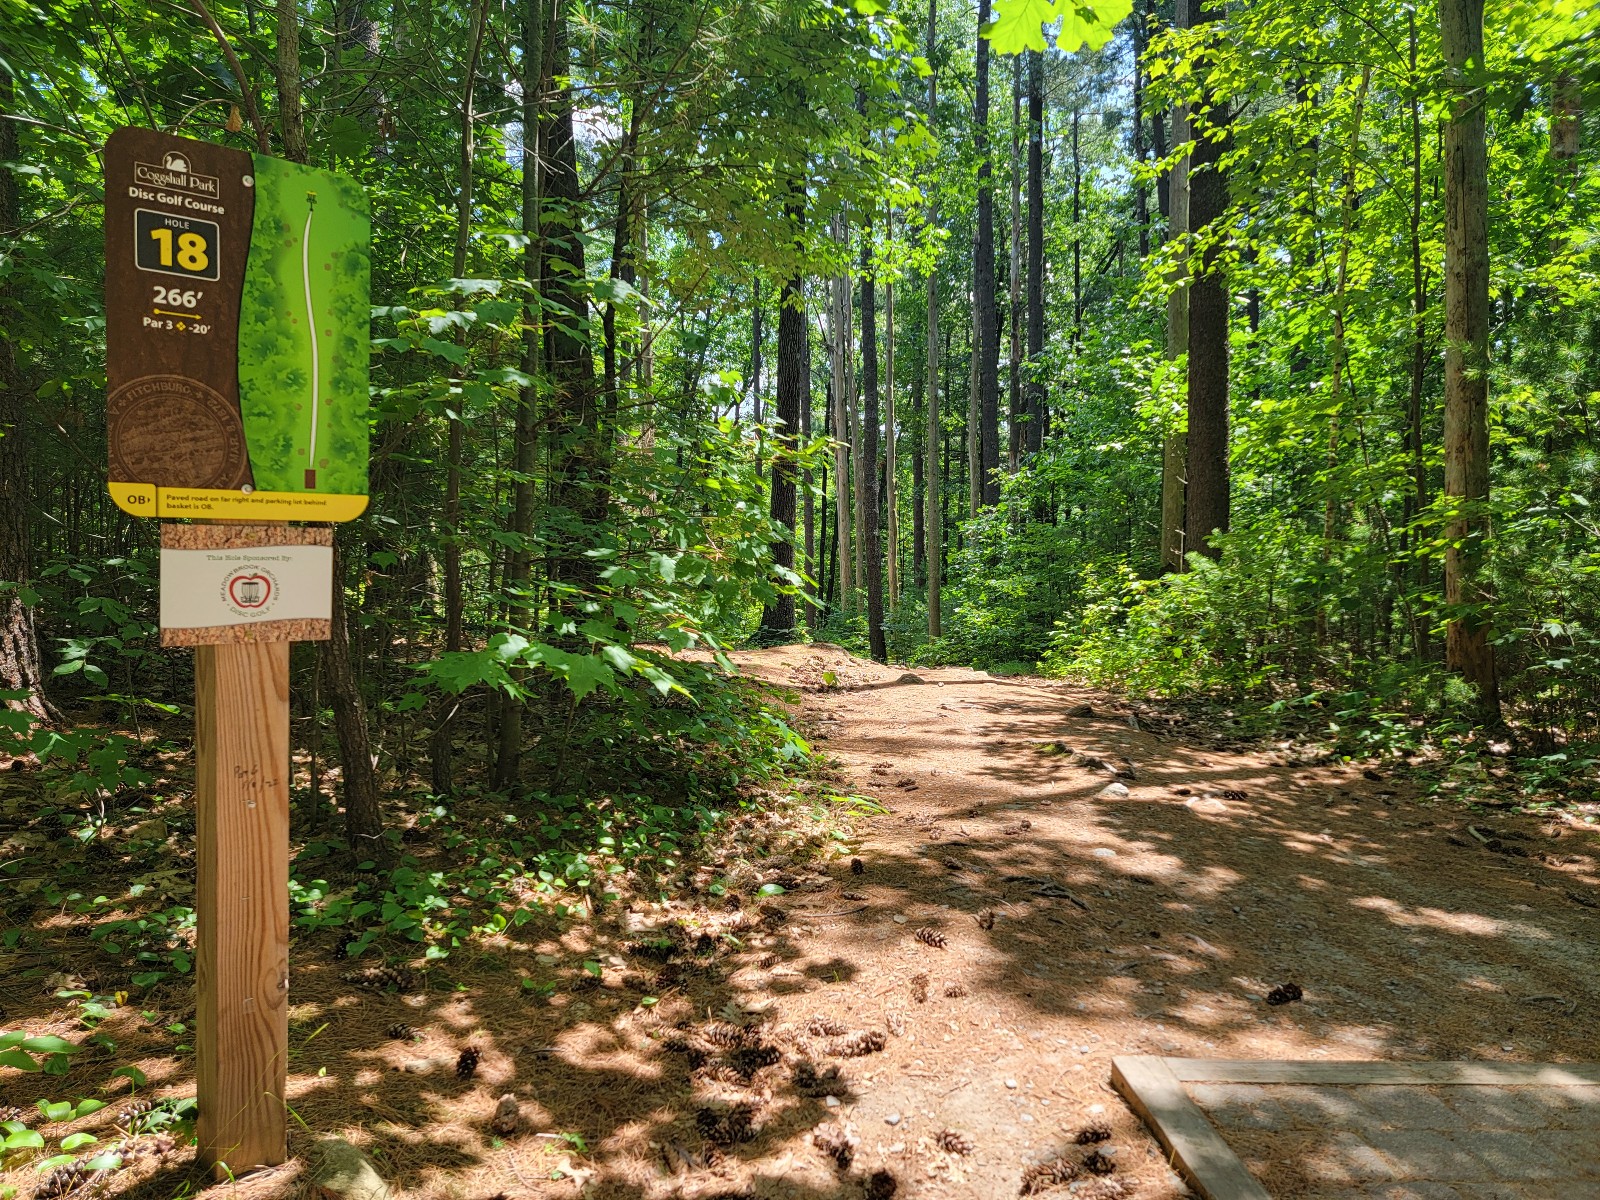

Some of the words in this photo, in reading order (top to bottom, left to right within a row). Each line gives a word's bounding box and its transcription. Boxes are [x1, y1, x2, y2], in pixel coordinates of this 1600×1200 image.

[137, 166, 187, 187] Coggshall
[190, 176, 216, 193] Park
[128, 186, 155, 201] Disc
[156, 193, 183, 206] Golf
[184, 198, 225, 215] Course
[164, 218, 190, 230] HOLE
[150, 228, 209, 272] 18
[153, 285, 204, 309] 266'
[143, 316, 163, 329] Par
[165, 320, 173, 330] 3
[127, 494, 146, 505] OB
[232, 496, 250, 505] right
[265, 498, 292, 507] parking
[243, 554, 279, 562] Sponsored
[220, 564, 260, 602] MEADOWBROOK
[229, 606, 249, 618] DISC
[249, 606, 271, 618] GOLF
